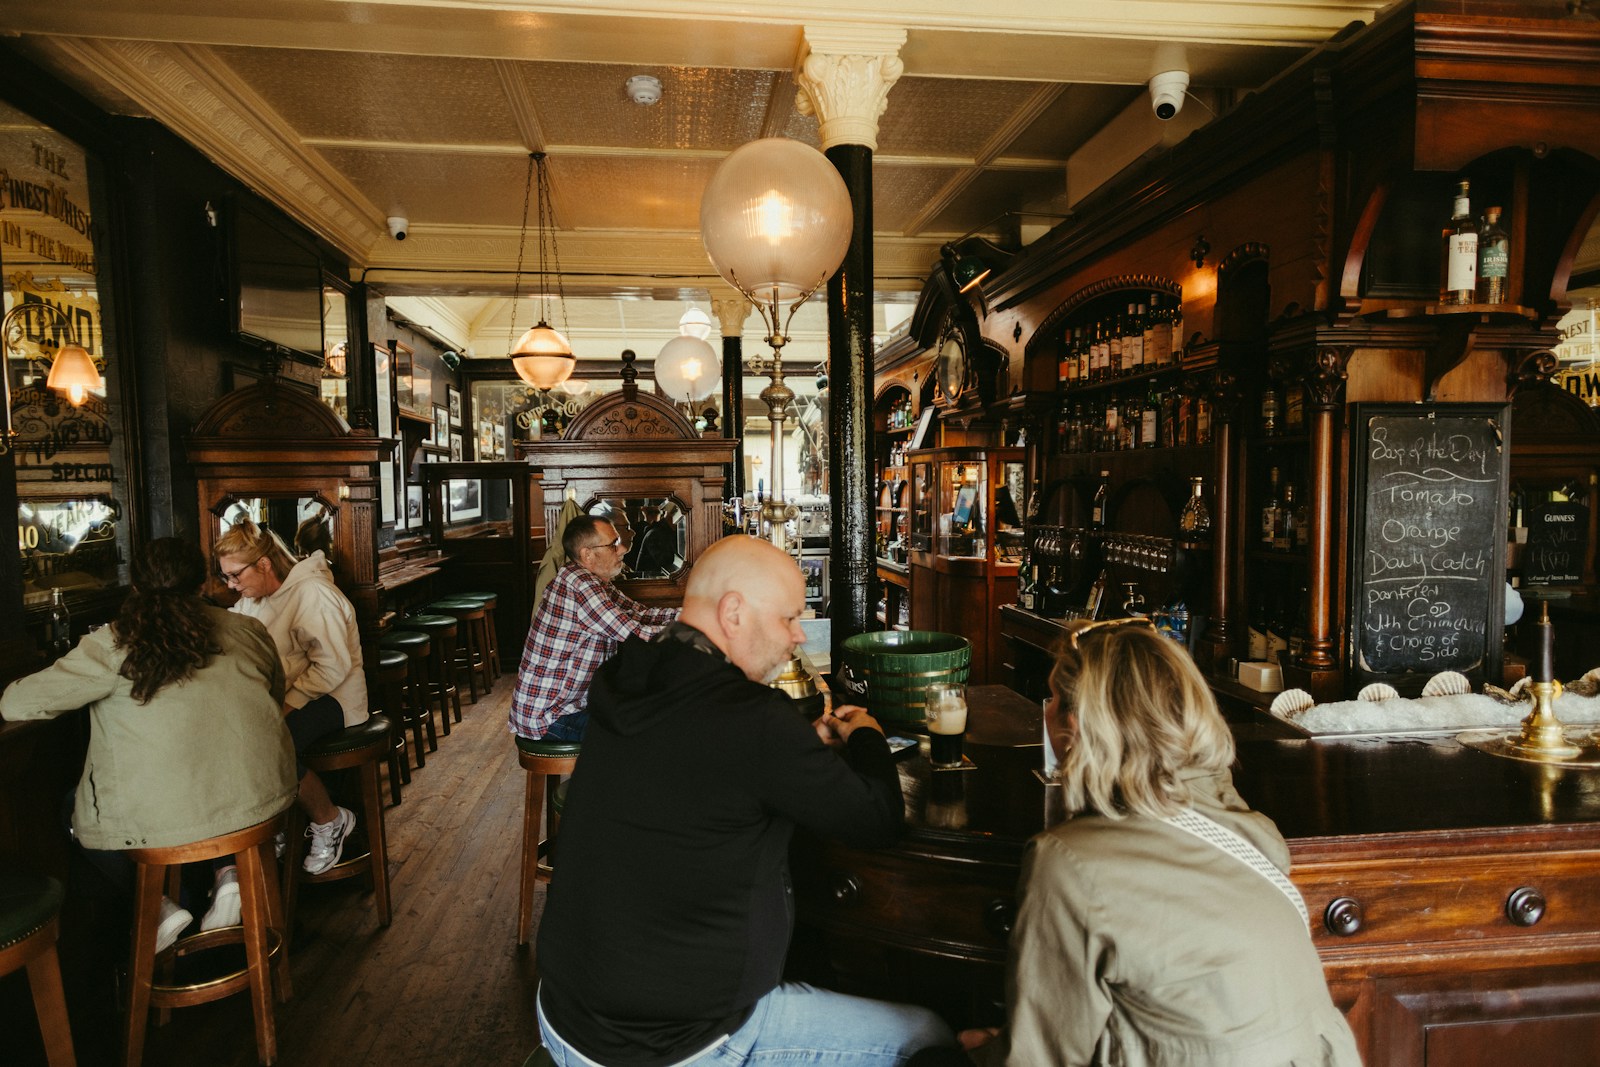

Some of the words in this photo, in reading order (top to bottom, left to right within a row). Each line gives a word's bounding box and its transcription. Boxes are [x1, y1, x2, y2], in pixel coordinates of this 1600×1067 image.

[32, 140, 69, 180] THE
[1, 220, 22, 249] IN
[25, 229, 56, 262] THE
[1410, 437, 1424, 465] of
[1427, 432, 1448, 459] the
[1449, 434, 1486, 475] Day
[51, 461, 119, 483] SPECIAL
[1371, 481, 1474, 506] Tomato
[1544, 513, 1575, 522] GUINNESS
[18, 525, 39, 550] 10
[1382, 519, 1460, 548] Orange
[1369, 549, 1427, 590] Daily
[1430, 549, 1485, 576] Catch
[1441, 632, 1460, 646] of
[1419, 647, 1459, 661] Side
